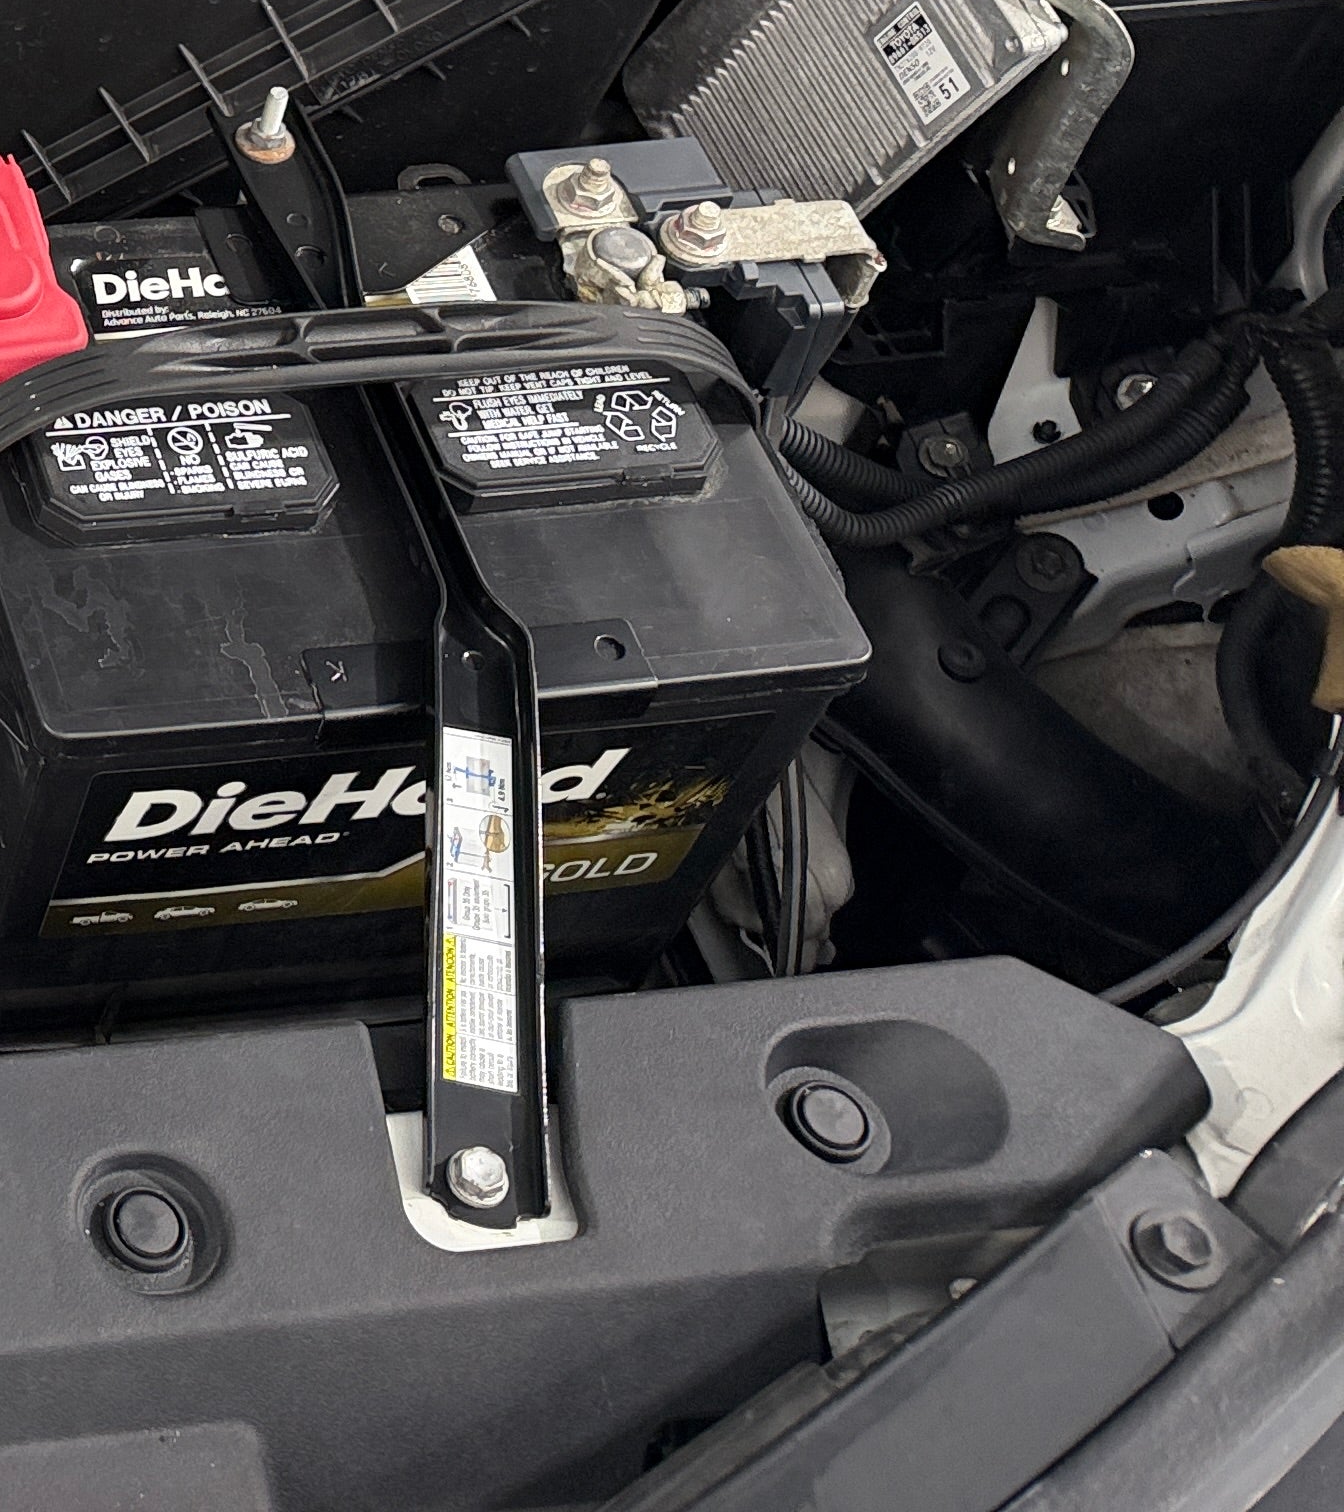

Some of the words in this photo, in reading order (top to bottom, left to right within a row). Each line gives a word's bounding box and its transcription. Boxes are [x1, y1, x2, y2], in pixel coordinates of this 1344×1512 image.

[890, 22, 920, 50] TOYOTA
[898, 58, 920, 81] DENSO
[91, 266, 231, 305] DieHa
[101, 306, 154, 319] Distributed
[154, 305, 170, 316] by:
[103, 316, 144, 328] Advance
[145, 313, 168, 324] Auto
[441, 389, 457, 397] DO
[457, 386, 477, 397] NOT
[497, 382, 522, 393] KEEP
[523, 380, 548, 390] VENT
[549, 377, 574, 388] CAPS
[604, 373, 624, 383] AND
[625, 371, 653, 382] LEVEL
[457, 377, 481, 387] KEEP
[482, 375, 502, 386] OUT
[503, 374, 516, 384] OF
[518, 372, 539, 382] THE
[539, 369, 570, 380] REACH
[570, 368, 584, 378] OF
[585, 364, 632, 376] CHILDREN
[472, 397, 503, 410] FLUSH
[501, 394, 527, 406] EYES
[526, 390, 584, 405] IMMEDIATELY
[74, 407, 168, 430] DANGER
[171, 404, 183, 422] /
[187, 398, 272, 420] POISON
[476, 408, 502, 420] WITH
[536, 402, 555, 414] GET
[482, 417, 522, 430] MEDICAL
[520, 414, 545, 426] HELP
[546, 412, 570, 424] FAST
[110, 435, 152, 448] SHIELD
[635, 442, 679, 453] RECYCLE
[113, 446, 144, 459] EYES
[179, 454, 201, 466] NO
[225, 448, 280, 462] SULFURIC
[281, 446, 309, 459] ACID
[90, 456, 152, 472] EXPLOSIVE
[229, 461, 251, 471] CAN
[251, 459, 285, 470] CAUSE
[288, 466, 305, 477] OR
[94, 469, 133, 483] GASES
[69, 484, 89, 495] CAN
[102, 747, 632, 844] DieHd
[86, 844, 209, 866] POWER
[219, 831, 341, 855] AHEAD
[445, 988, 455, 1027] ATTENTION
[445, 1033, 455, 1066] CAUTION
